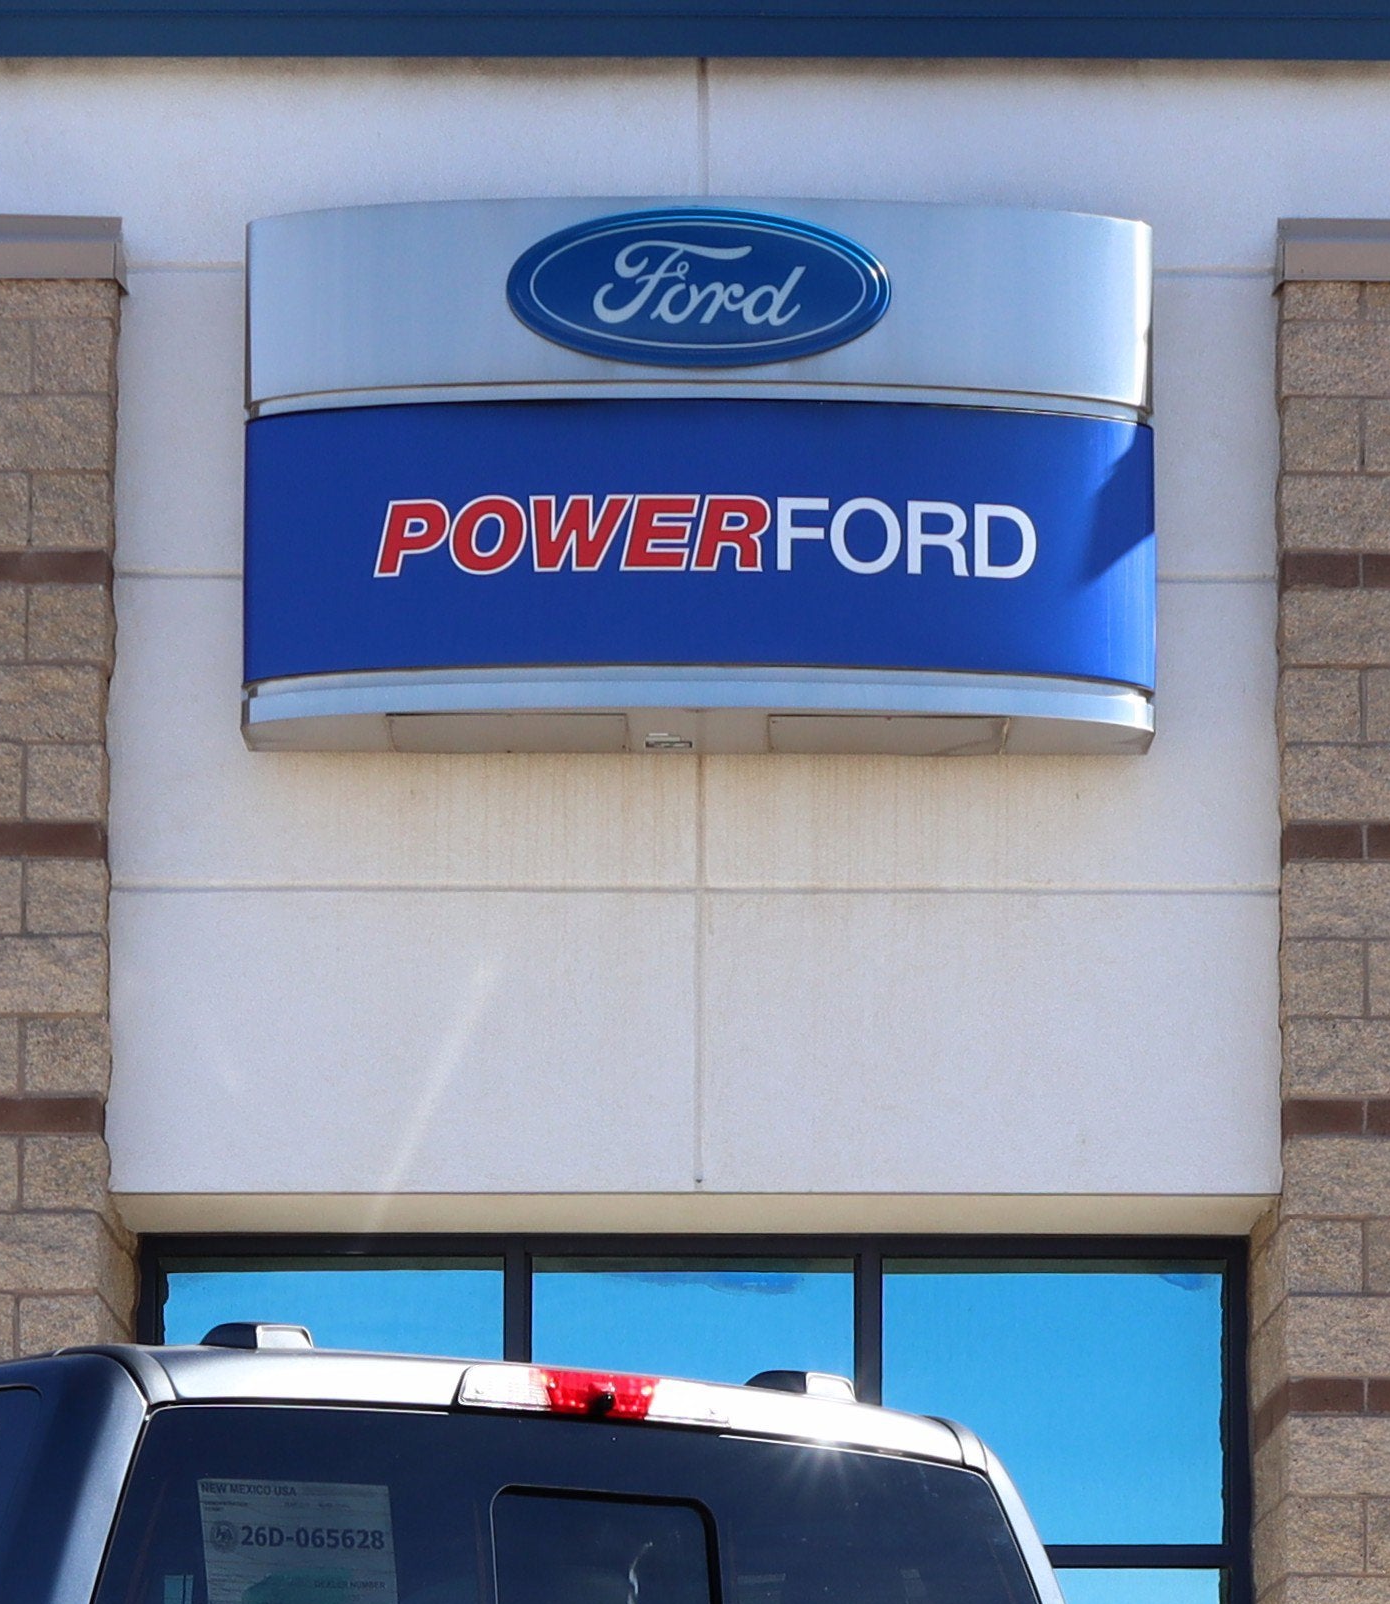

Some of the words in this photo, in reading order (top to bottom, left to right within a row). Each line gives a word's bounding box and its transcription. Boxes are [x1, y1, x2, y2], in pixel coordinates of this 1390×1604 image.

[592, 240, 802, 328] Ford
[372, 493, 1037, 580] POWERFORD
[200, 1482, 226, 1495] NEW
[229, 1484, 271, 1496] MEXICO
[274, 1485, 297, 1497] USA
[241, 1525, 385, 1550] 26D-065628
